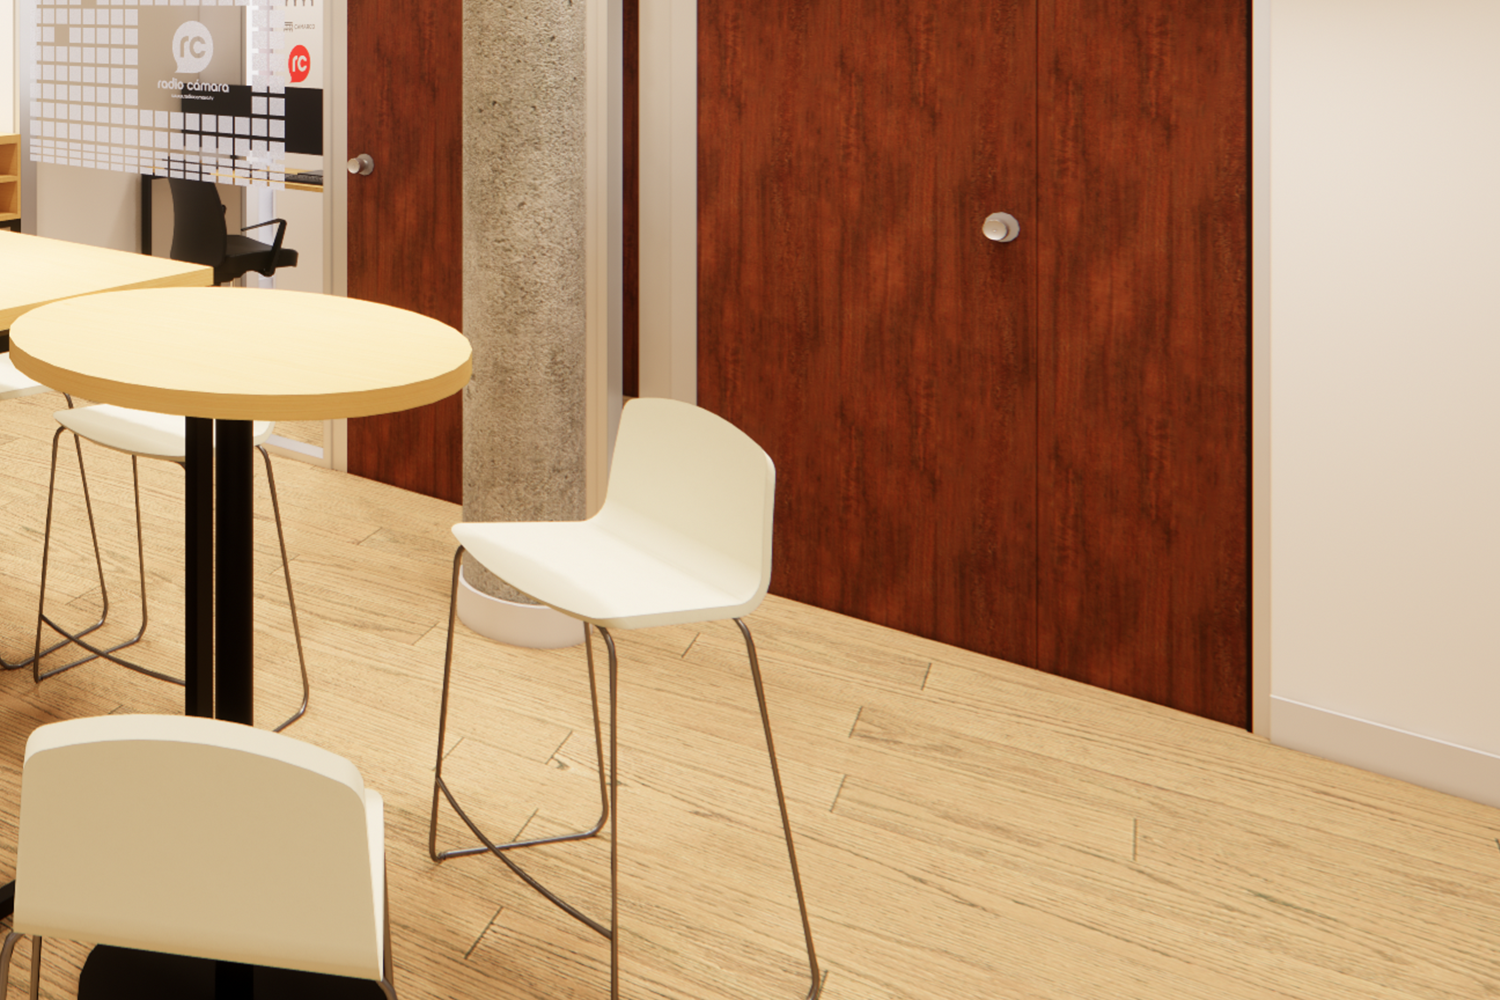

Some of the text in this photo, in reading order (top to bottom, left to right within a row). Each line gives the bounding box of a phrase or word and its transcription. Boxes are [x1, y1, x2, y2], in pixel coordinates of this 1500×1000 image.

[180, 35, 206, 59] rc
[157, 77, 230, 93] radio cámara
